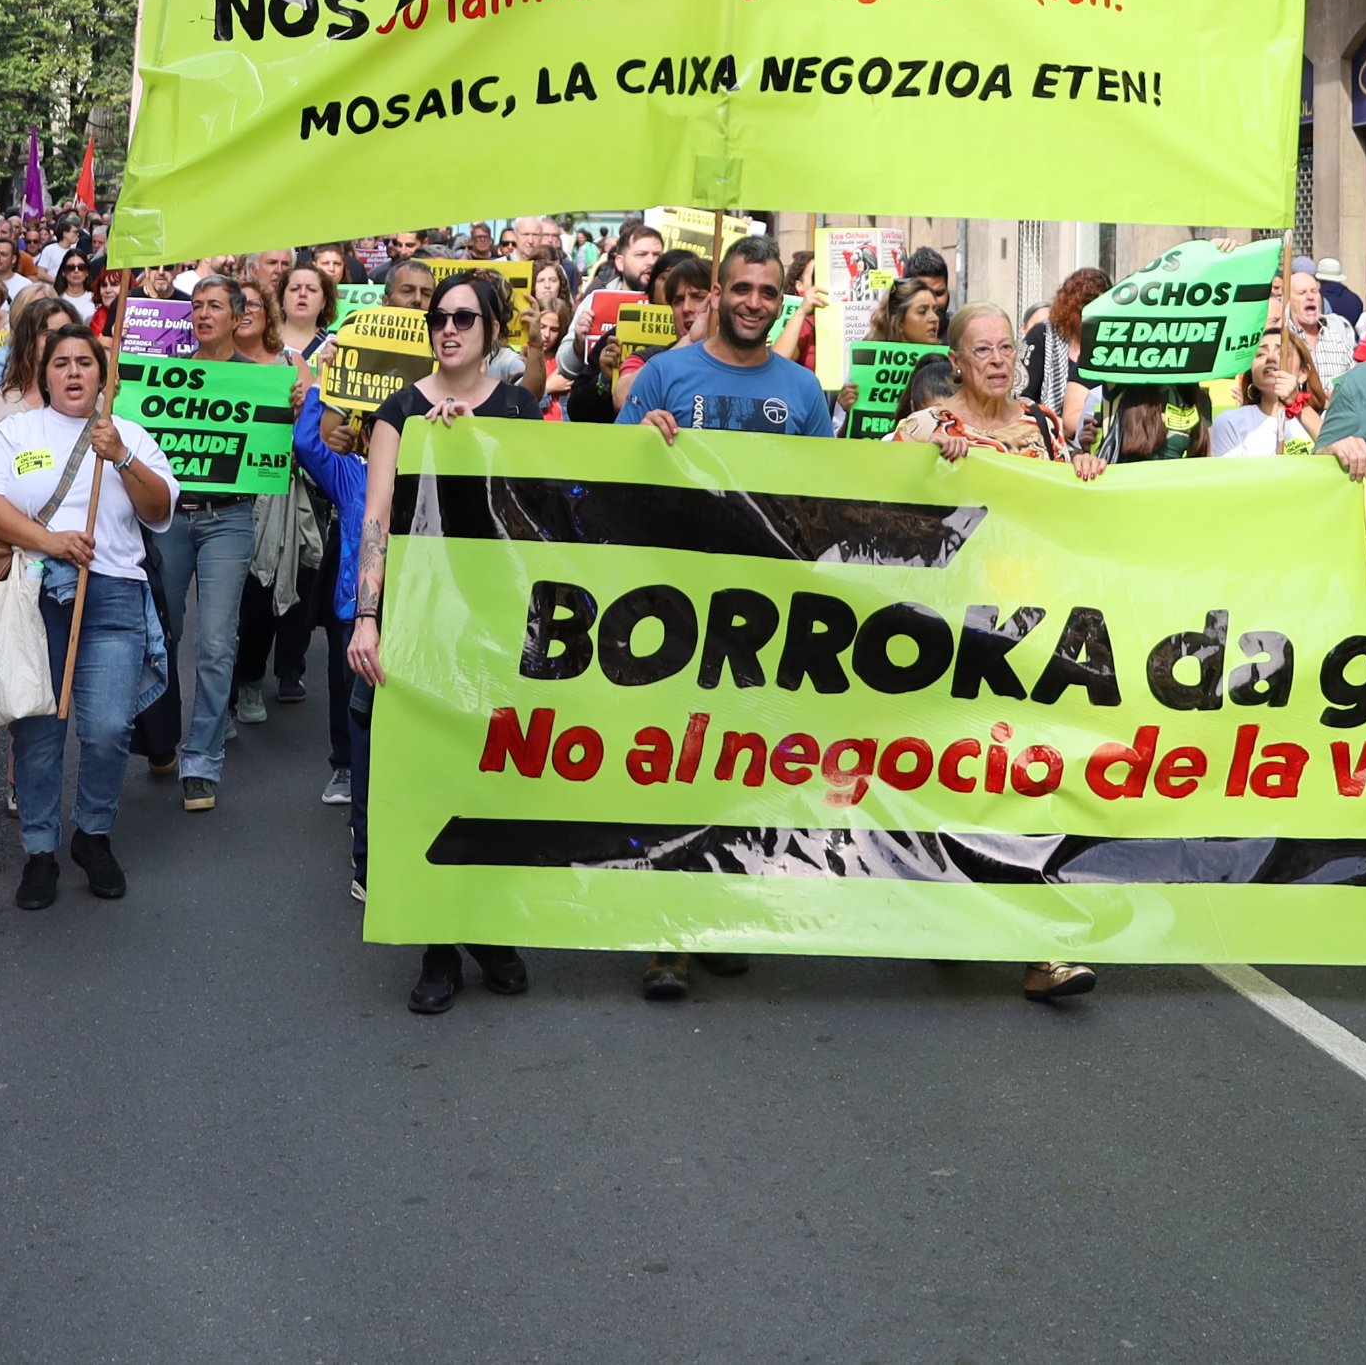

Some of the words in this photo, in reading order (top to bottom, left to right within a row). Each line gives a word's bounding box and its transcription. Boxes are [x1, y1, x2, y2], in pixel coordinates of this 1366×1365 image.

[301, 76, 517, 140] MOSAIC,
[537, 61, 598, 105] LA
[616, 55, 741, 96] CAIXA
[760, 56, 1013, 102] NEGOZIOA
[1032, 63, 1162, 107] ETEN!
[1141, 250, 1182, 273] OS
[1111, 282, 1232, 307] OCHOS
[124, 316, 163, 328] fondos
[165, 318, 194, 329] buitr
[356, 313, 427, 331] ETXEBIZITZ
[642, 323, 676, 334] ESKUB
[1095, 321, 1130, 342] EZ
[1132, 321, 1219, 343] DAUDE
[355, 324, 425, 343] ESKUBIDEA
[1225, 334, 1260, 352] LAB
[878, 350, 919, 366] NOS
[1090, 346, 1190, 368] SALGAI
[146, 366, 207, 390] LOS
[348, 370, 404, 389] NEGOCIO
[326, 380, 341, 394] DE
[346, 383, 362, 397] LA
[141, 395, 252, 424] OCHOS
[160, 433, 240, 455] DAUDE
[171, 457, 213, 476] GAI
[246, 451, 288, 469] LAB
[519, 580, 1121, 707] BORROKA
[1146, 609, 1294, 711] da
[480, 707, 605, 782] No
[626, 712, 711, 785] al
[714, 721, 1063, 806] negocio
[1085, 725, 1208, 800] de
[1226, 723, 1310, 800] la
